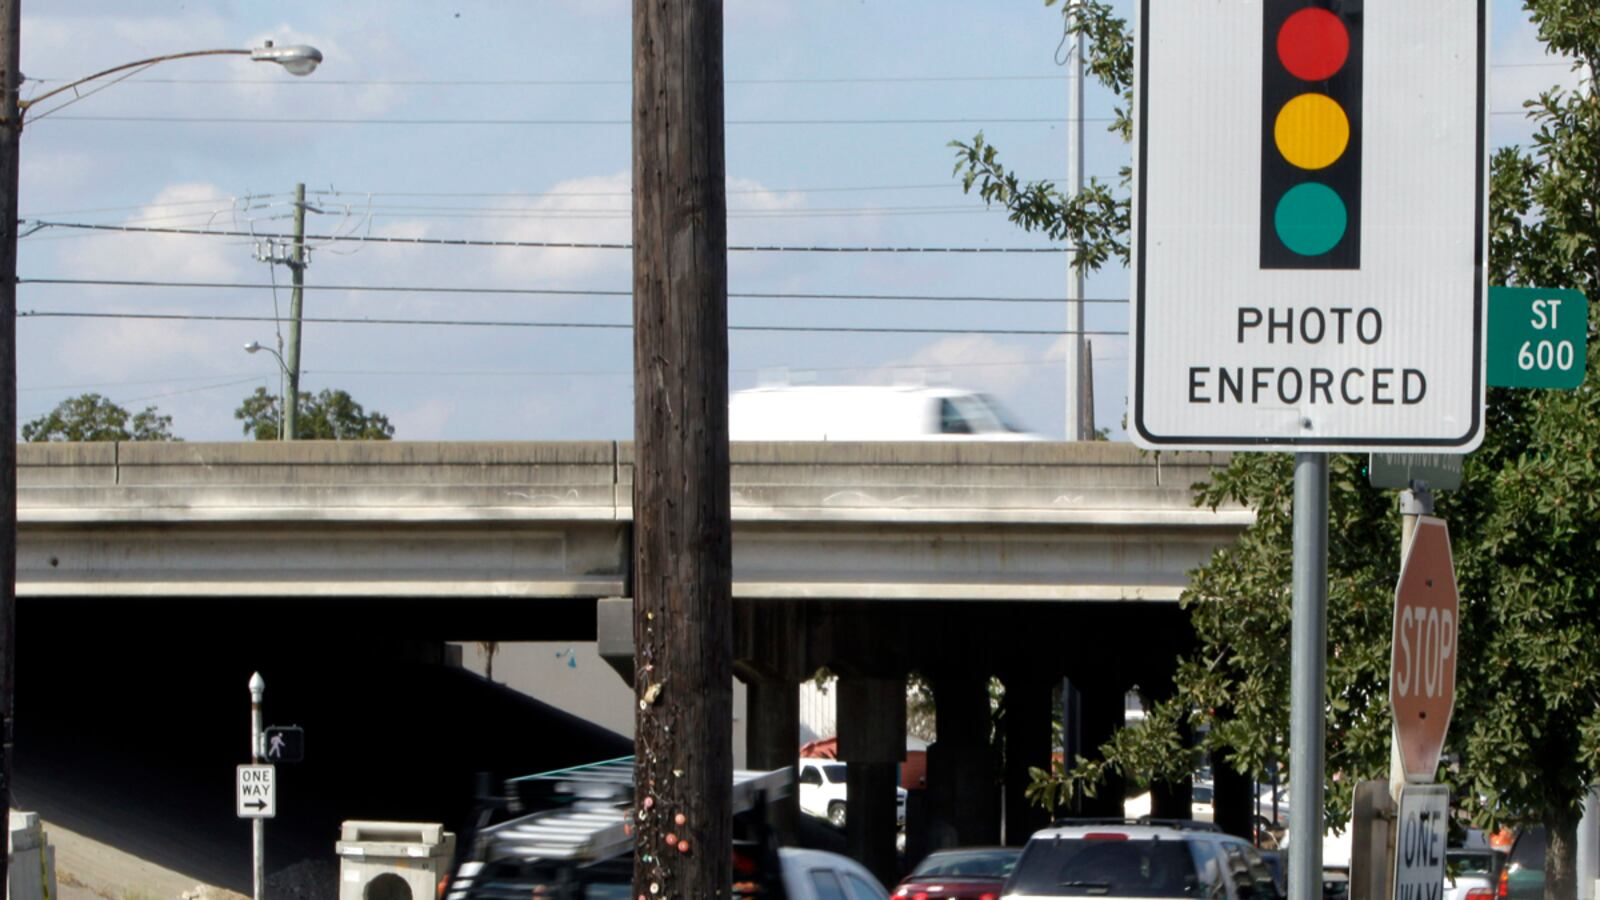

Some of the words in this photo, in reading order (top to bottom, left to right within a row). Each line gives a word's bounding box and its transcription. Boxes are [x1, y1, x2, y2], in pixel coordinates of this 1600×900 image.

[1237, 307, 1383, 345] PHOTO
[1530, 299, 1562, 330] ST
[1517, 340, 1574, 371] 600
[1188, 367, 1427, 405] ENFORCED
[1397, 605, 1454, 698] STOP
[242, 770, 270, 782] ONE
[242, 784, 270, 796] WAY
[1404, 811, 1442, 868] ONE
